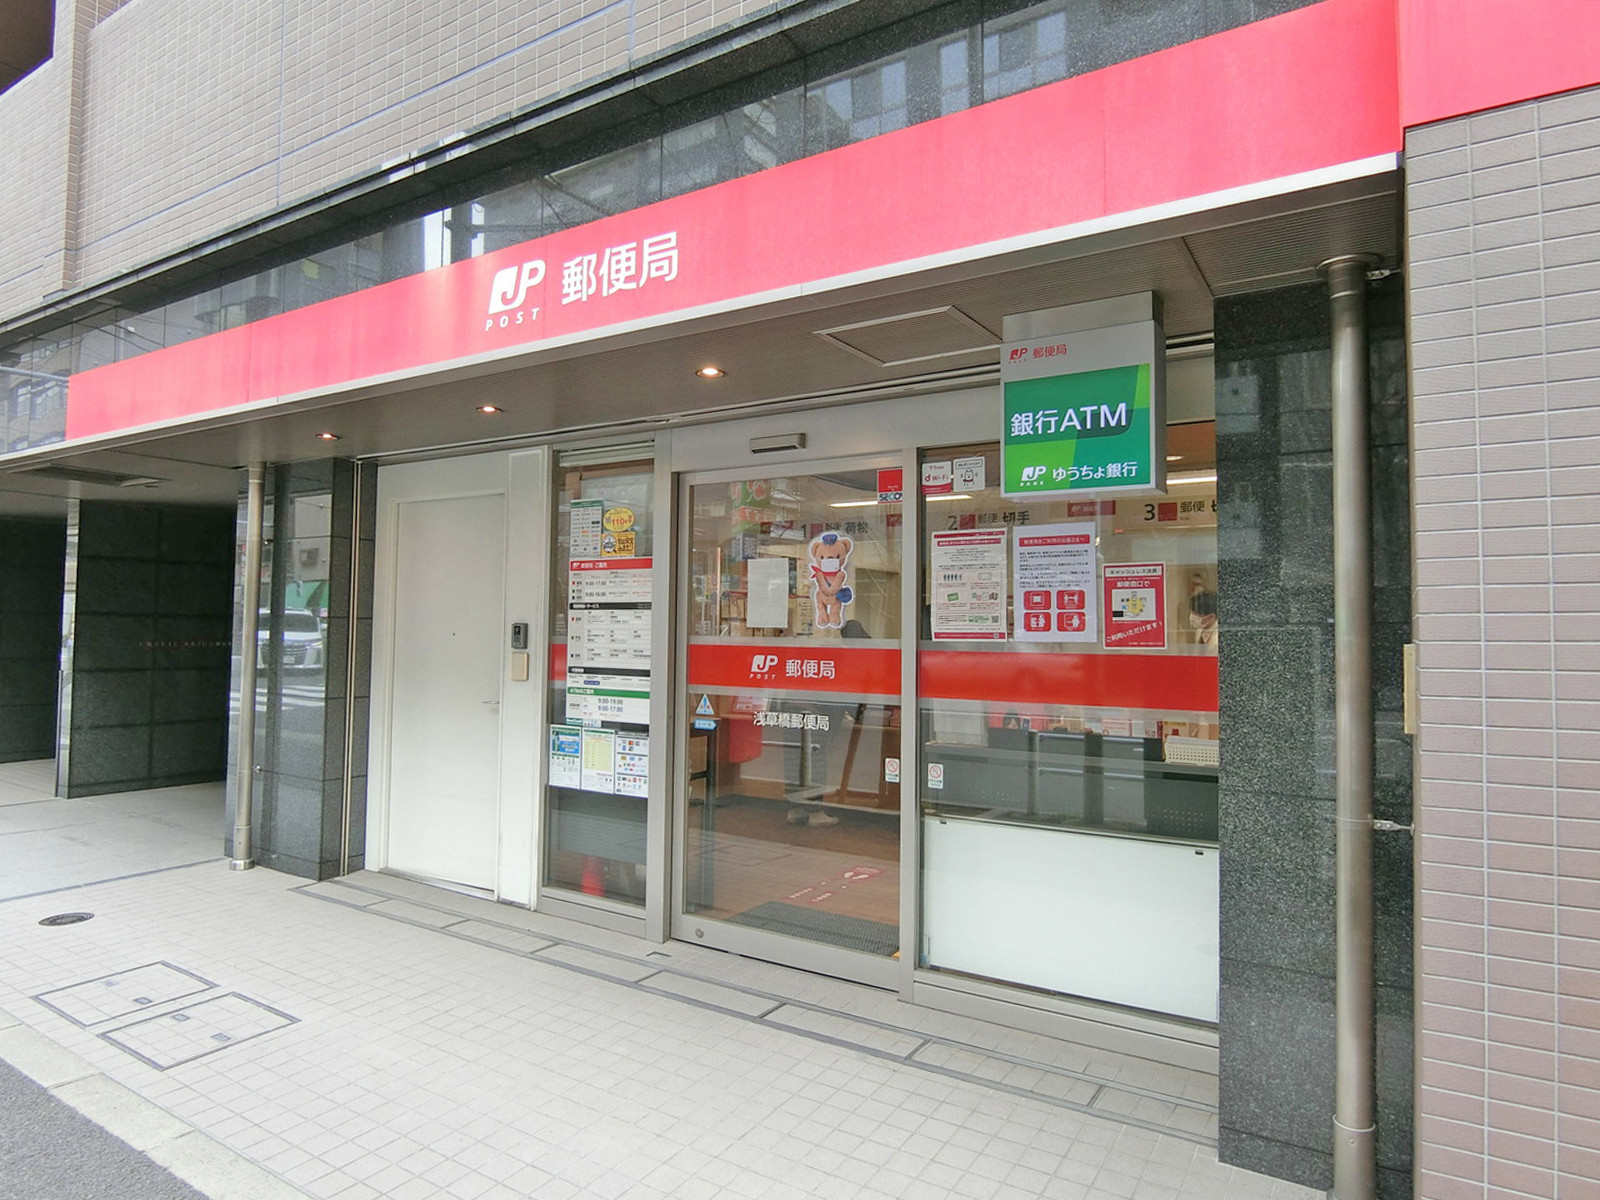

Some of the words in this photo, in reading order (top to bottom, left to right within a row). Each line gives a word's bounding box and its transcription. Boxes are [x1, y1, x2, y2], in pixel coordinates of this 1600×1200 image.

[561, 231, 679, 305] 郵便局
[485, 307, 540, 331] POST
[1033, 344, 1067, 359] 郵便局
[1010, 402, 1127, 437] 銀行ATM
[1052, 461, 1138, 482] ゆうちょ銀行
[1002, 510, 1030, 525] 切手
[1144, 504, 1155, 521] 3
[1180, 501, 1205, 512] 郵便
[785, 659, 836, 680] 郵便局
[754, 711, 829, 731] 浅草橋郵便局
